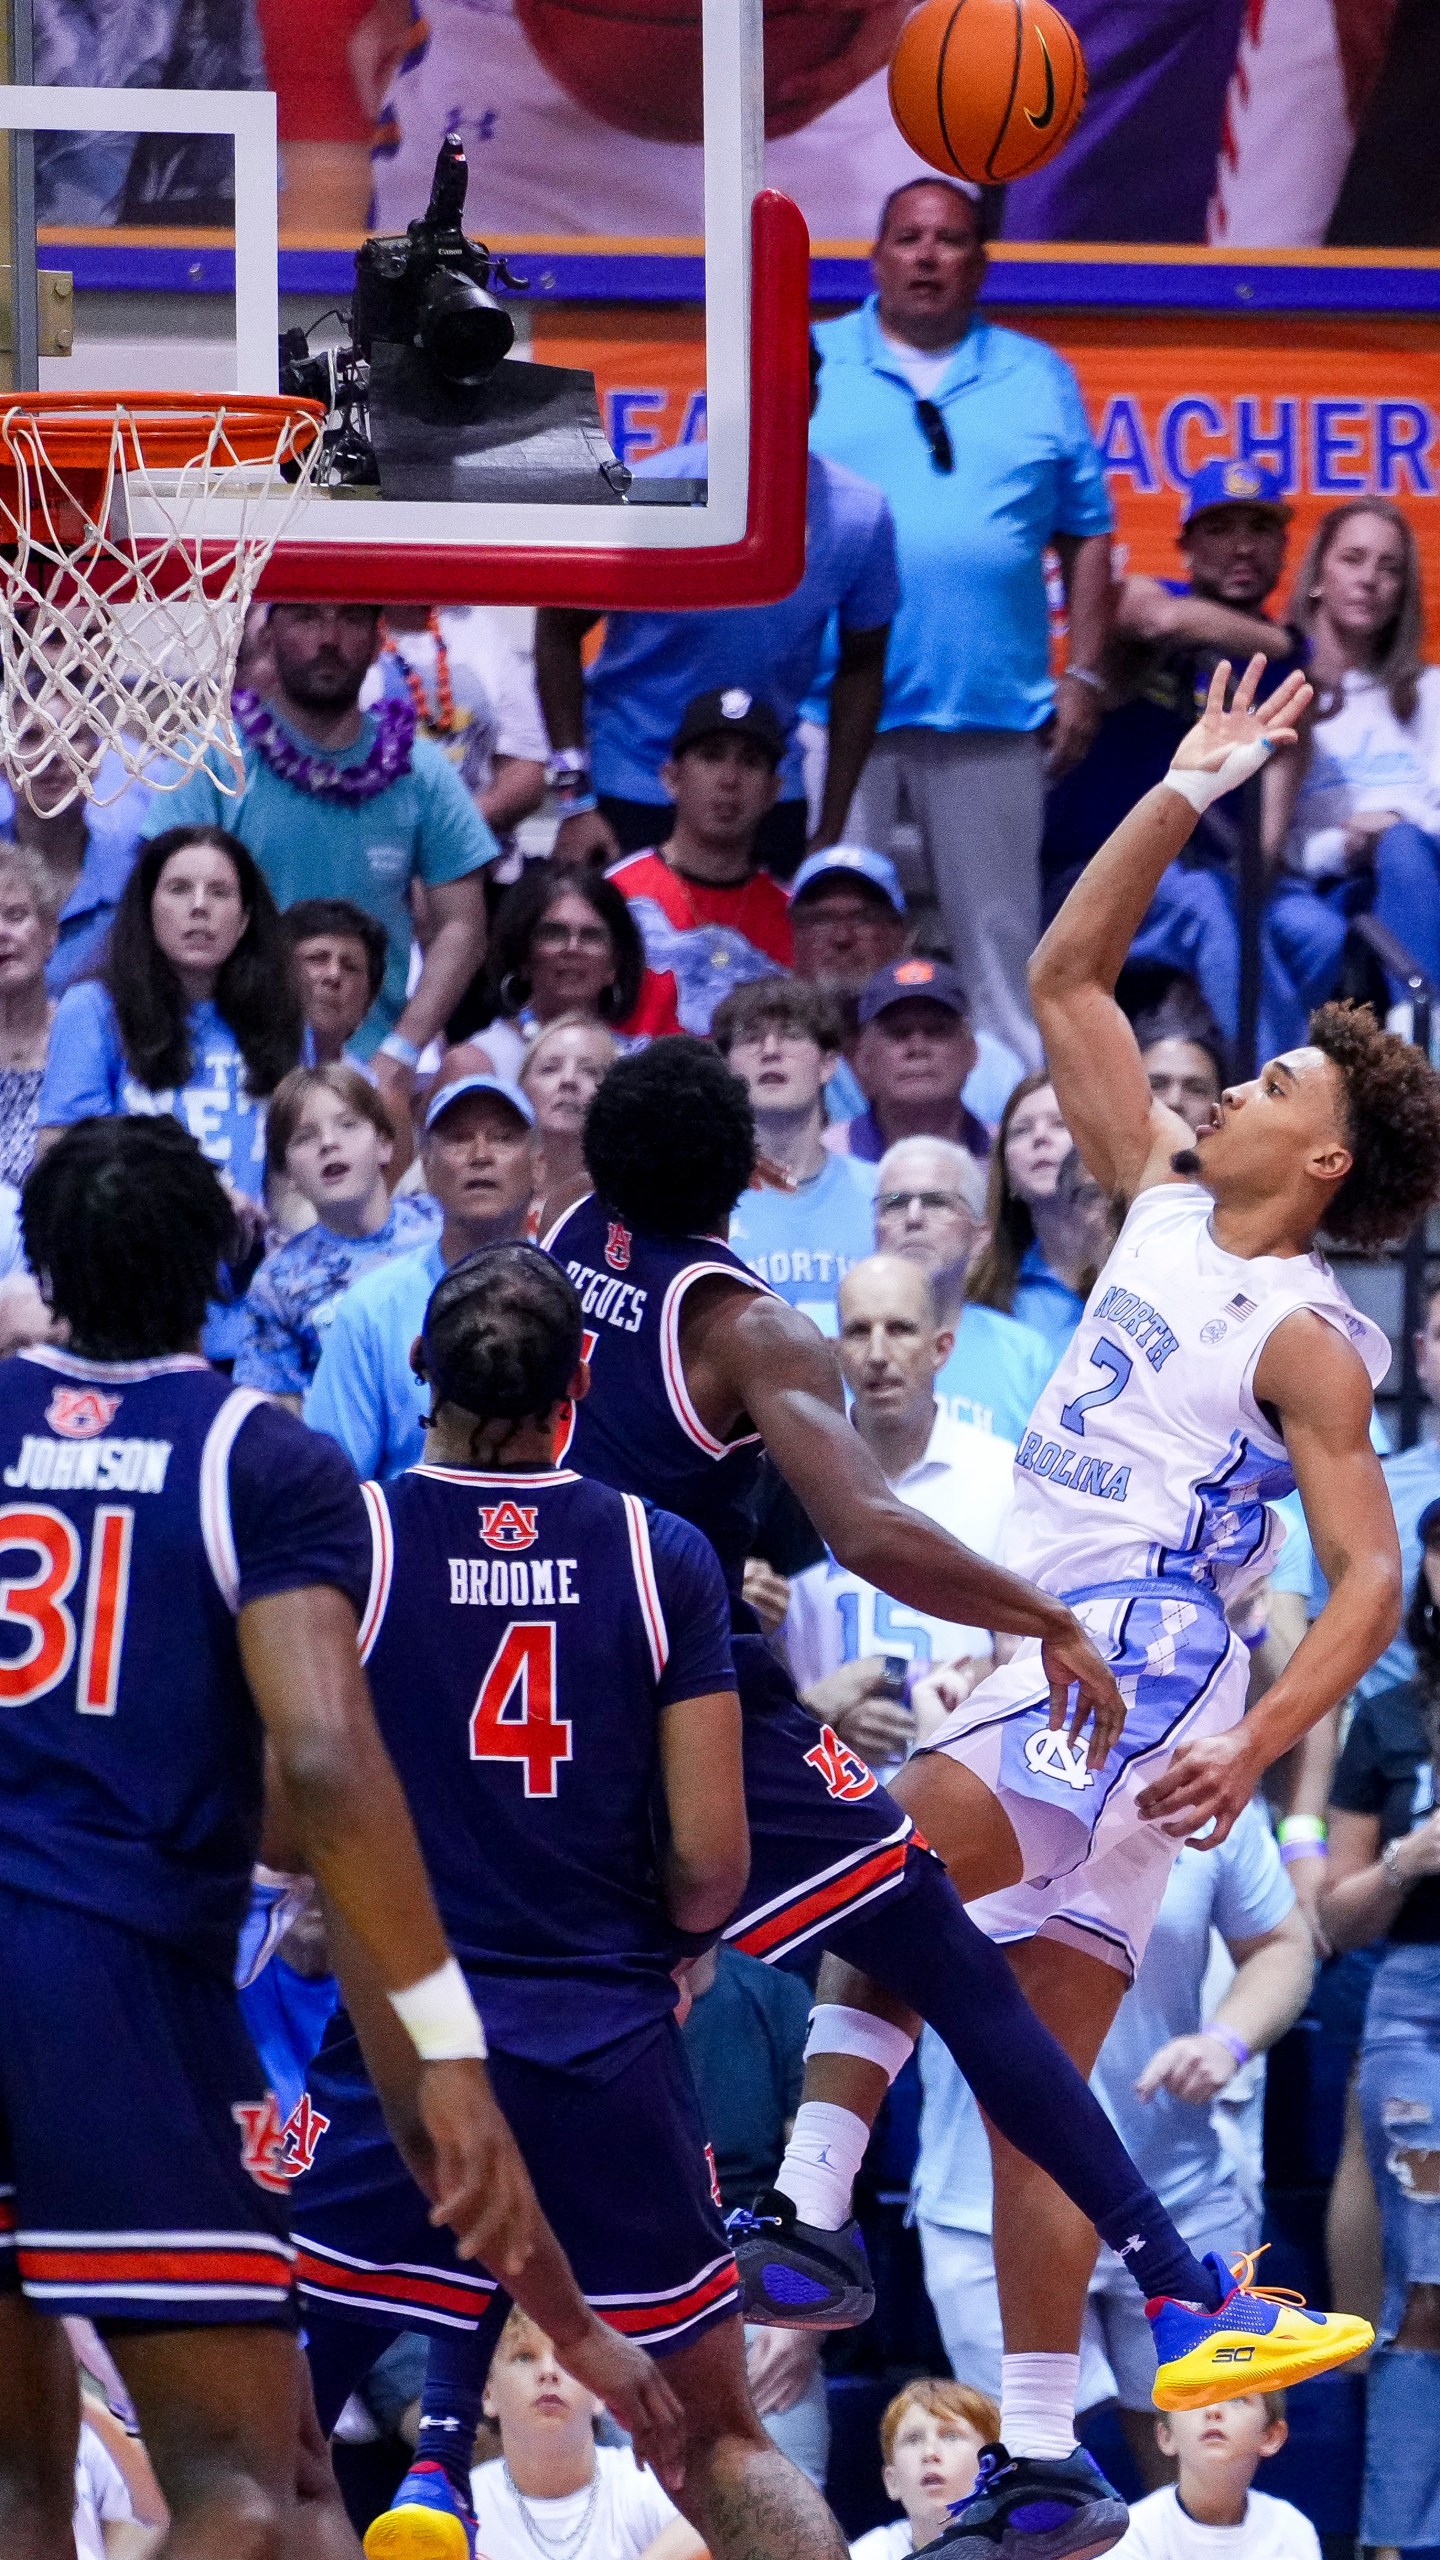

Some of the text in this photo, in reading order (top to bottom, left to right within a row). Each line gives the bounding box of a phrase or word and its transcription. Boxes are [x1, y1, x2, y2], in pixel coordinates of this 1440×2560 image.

[1093, 1286, 1180, 1373] NORTH
[1060, 1336, 1134, 1437] 7
[3, 1435, 172, 1493] JOHNSON
[1014, 1427, 1132, 1502] ROLINA
[0, 1502, 135, 1717] 31
[448, 1558, 580, 1606] BROOME
[836, 1592, 933, 1668] 15
[469, 1621, 573, 1798] 4
